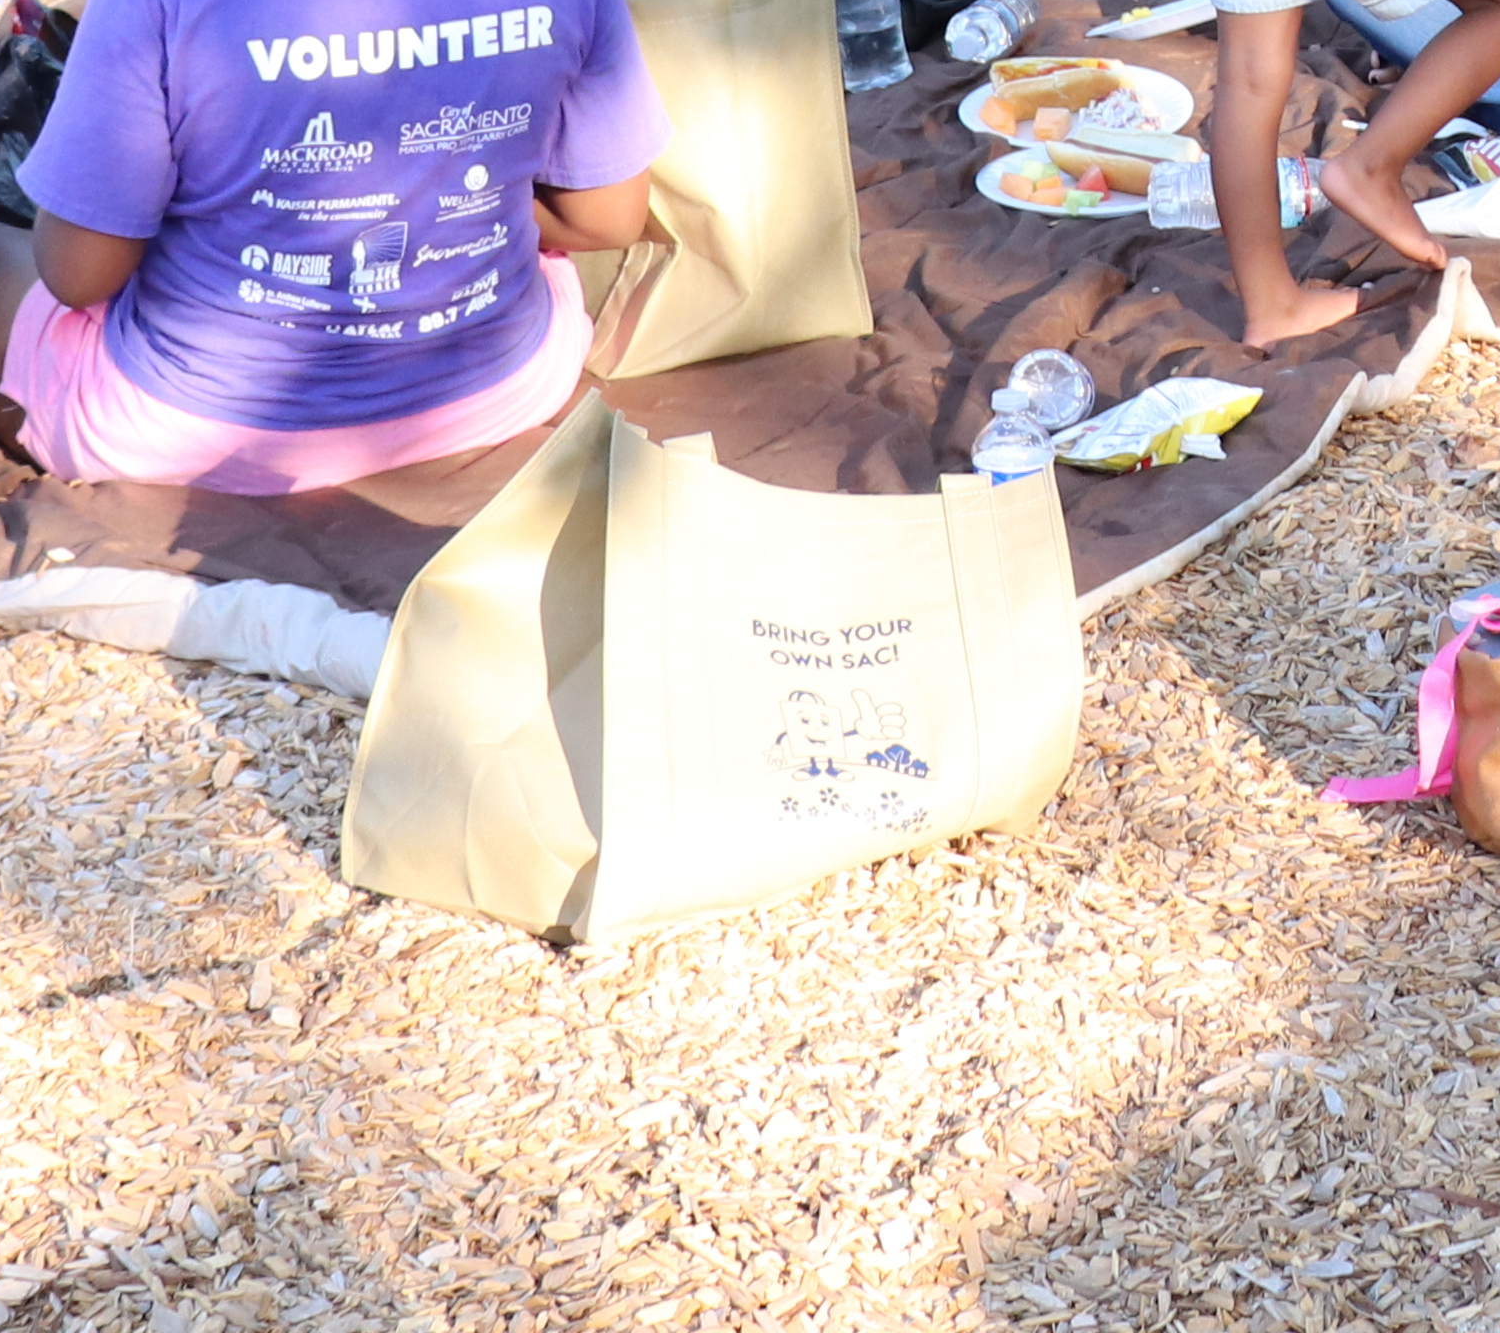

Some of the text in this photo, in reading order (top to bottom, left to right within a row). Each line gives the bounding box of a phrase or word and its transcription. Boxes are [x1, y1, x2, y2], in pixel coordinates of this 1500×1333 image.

[246, 5, 554, 82] VOLUNTEER
[400, 102, 533, 142] SACRAMENTO
[398, 143, 436, 155] MAYOR
[436, 141, 458, 152] PRO
[275, 197, 316, 210] KAISER
[297, 208, 389, 222] in the community
[271, 251, 334, 278] BAYSIDE
[751, 617, 914, 647] BRING YOUR
[769, 643, 900, 670] OWN SAC!
